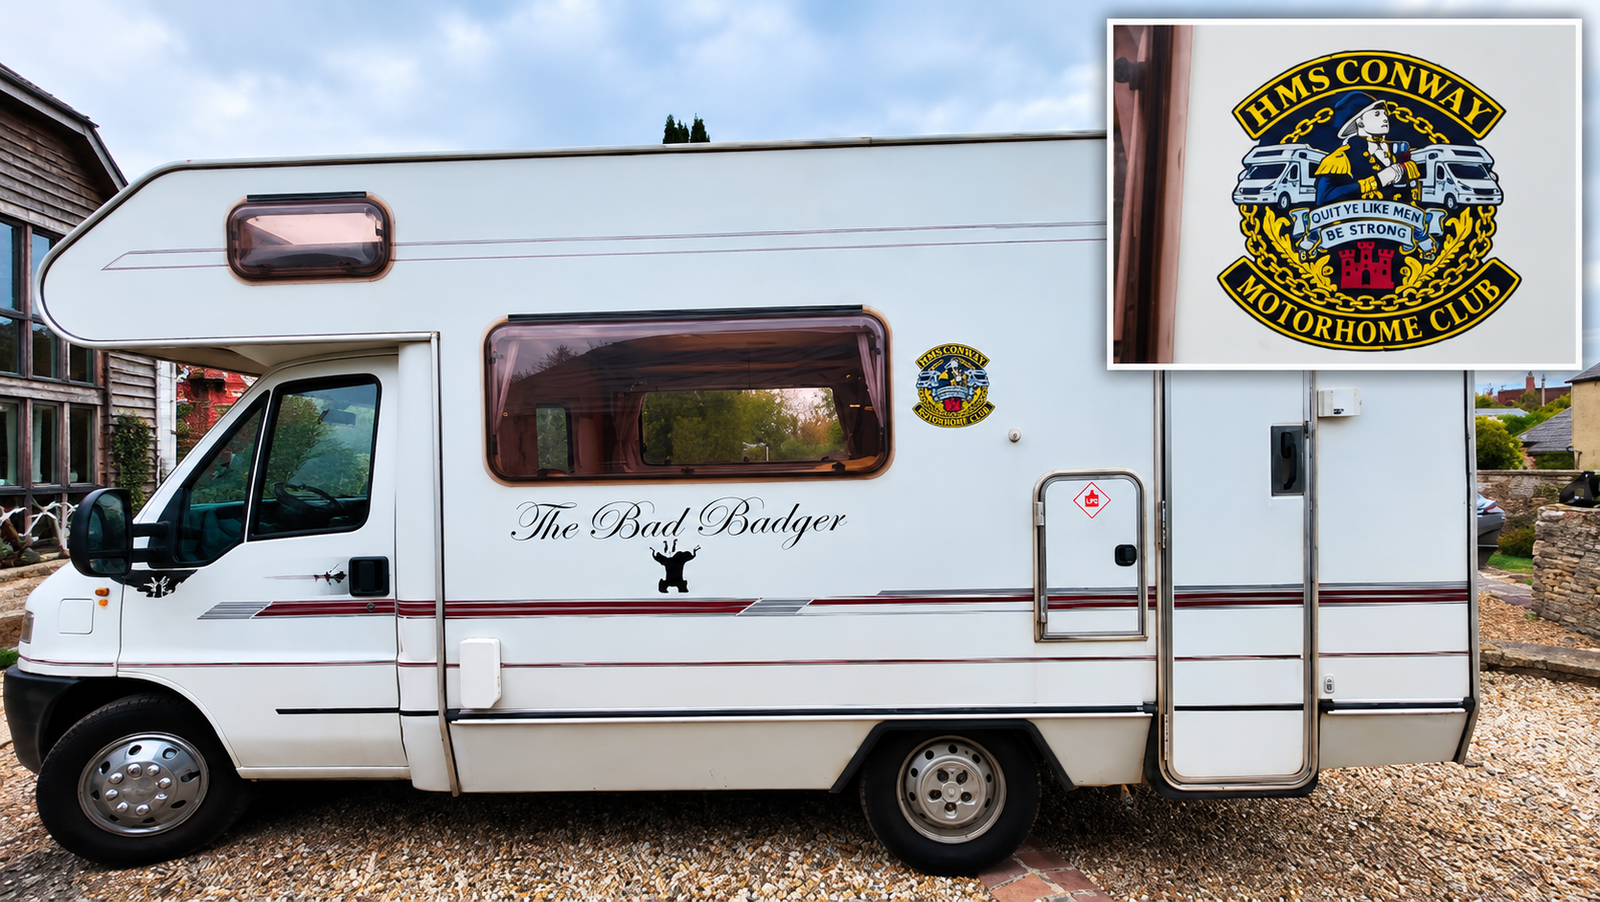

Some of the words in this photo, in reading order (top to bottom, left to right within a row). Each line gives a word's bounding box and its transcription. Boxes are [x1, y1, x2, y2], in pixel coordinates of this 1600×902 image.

[1245, 66, 1330, 128] HMS
[1336, 59, 1491, 126] CONWAY
[1326, 227, 1345, 241] BE
[1349, 223, 1407, 239] STRONG
[1344, 204, 1359, 214] YE
[1362, 203, 1389, 214] LIKE
[1393, 206, 1421, 223] MEN
[1237, 275, 1422, 343] MOTORHOME
[1429, 279, 1500, 332] CLUB
[511, 501, 580, 541] The
[590, 500, 691, 540] Bad
[697, 496, 847, 550] Badger
